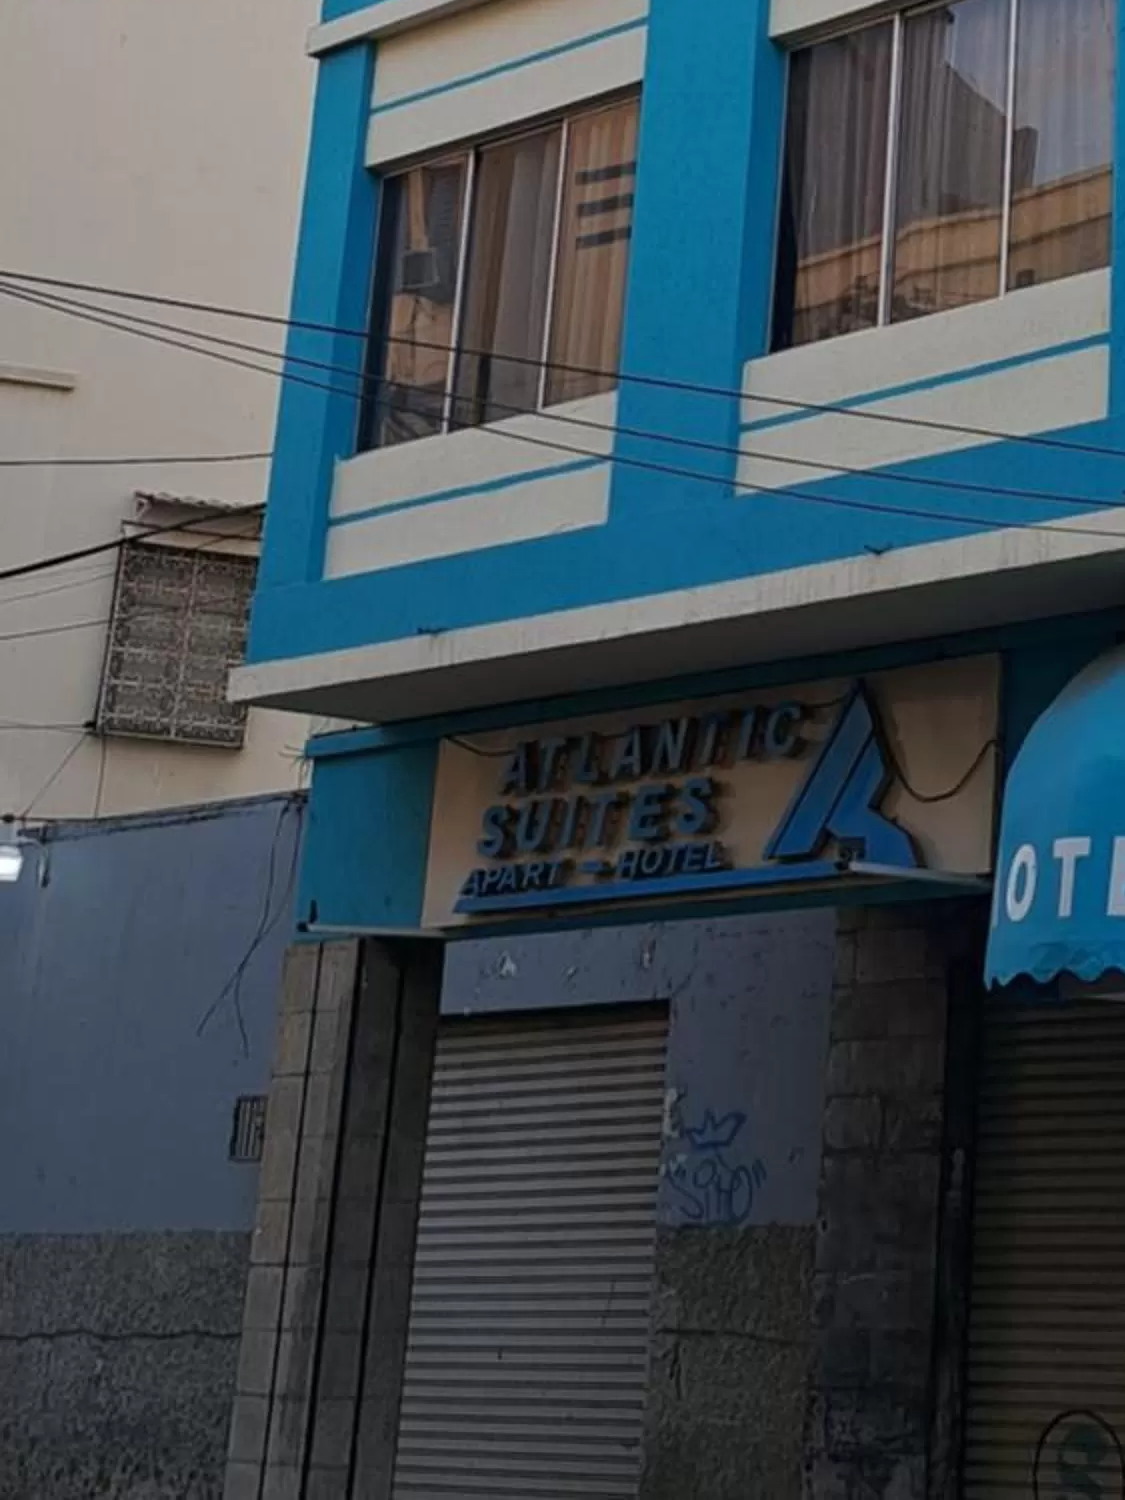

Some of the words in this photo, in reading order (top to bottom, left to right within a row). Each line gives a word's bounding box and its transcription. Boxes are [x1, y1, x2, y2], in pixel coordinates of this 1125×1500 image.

[502, 704, 805, 794] ATLANTIC
[477, 779, 715, 858] SUITES
[464, 862, 561, 897] APART
[619, 841, 726, 878] HOTEL
